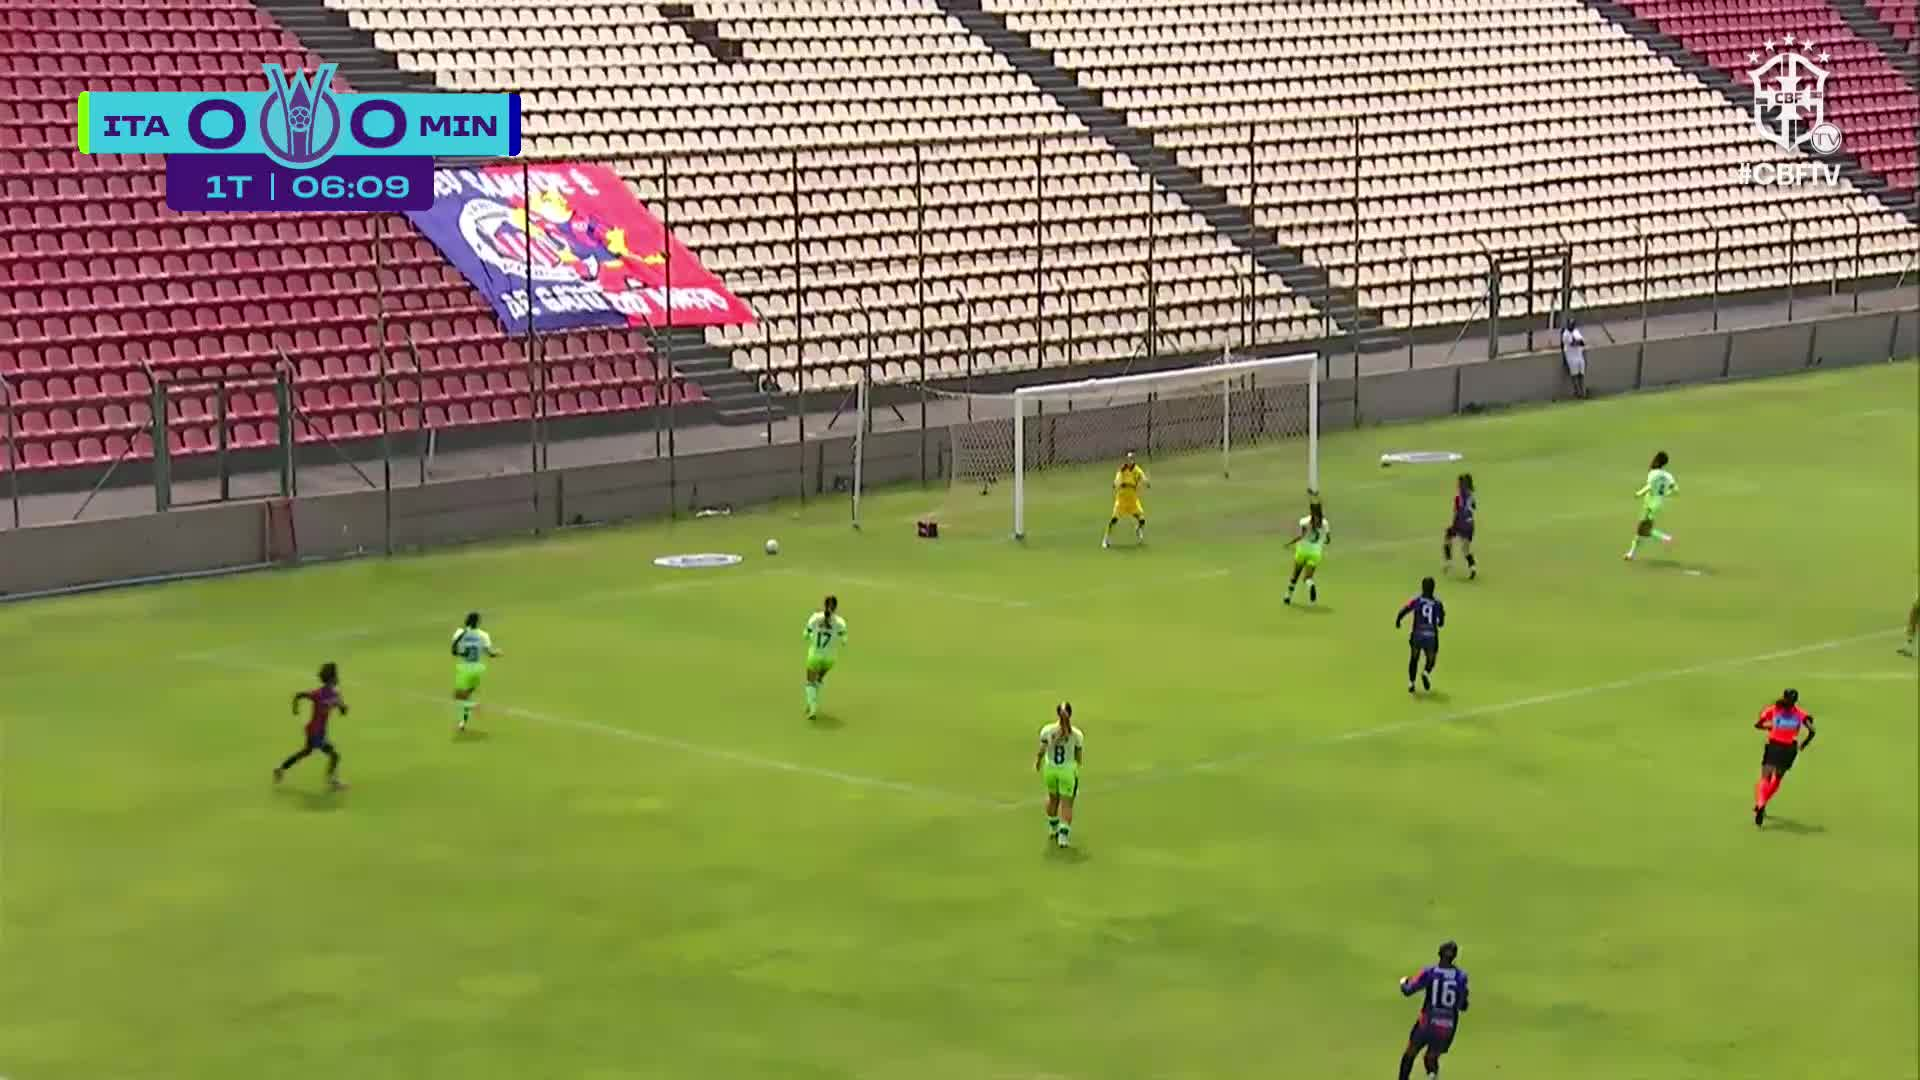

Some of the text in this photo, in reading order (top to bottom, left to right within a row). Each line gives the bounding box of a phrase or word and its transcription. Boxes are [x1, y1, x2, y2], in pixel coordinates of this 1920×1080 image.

[1422, 604, 1433, 624] 9
[816, 631, 831, 649] 17
[1055, 744, 1065, 765] 8
[1431, 979, 1457, 1008] 16
